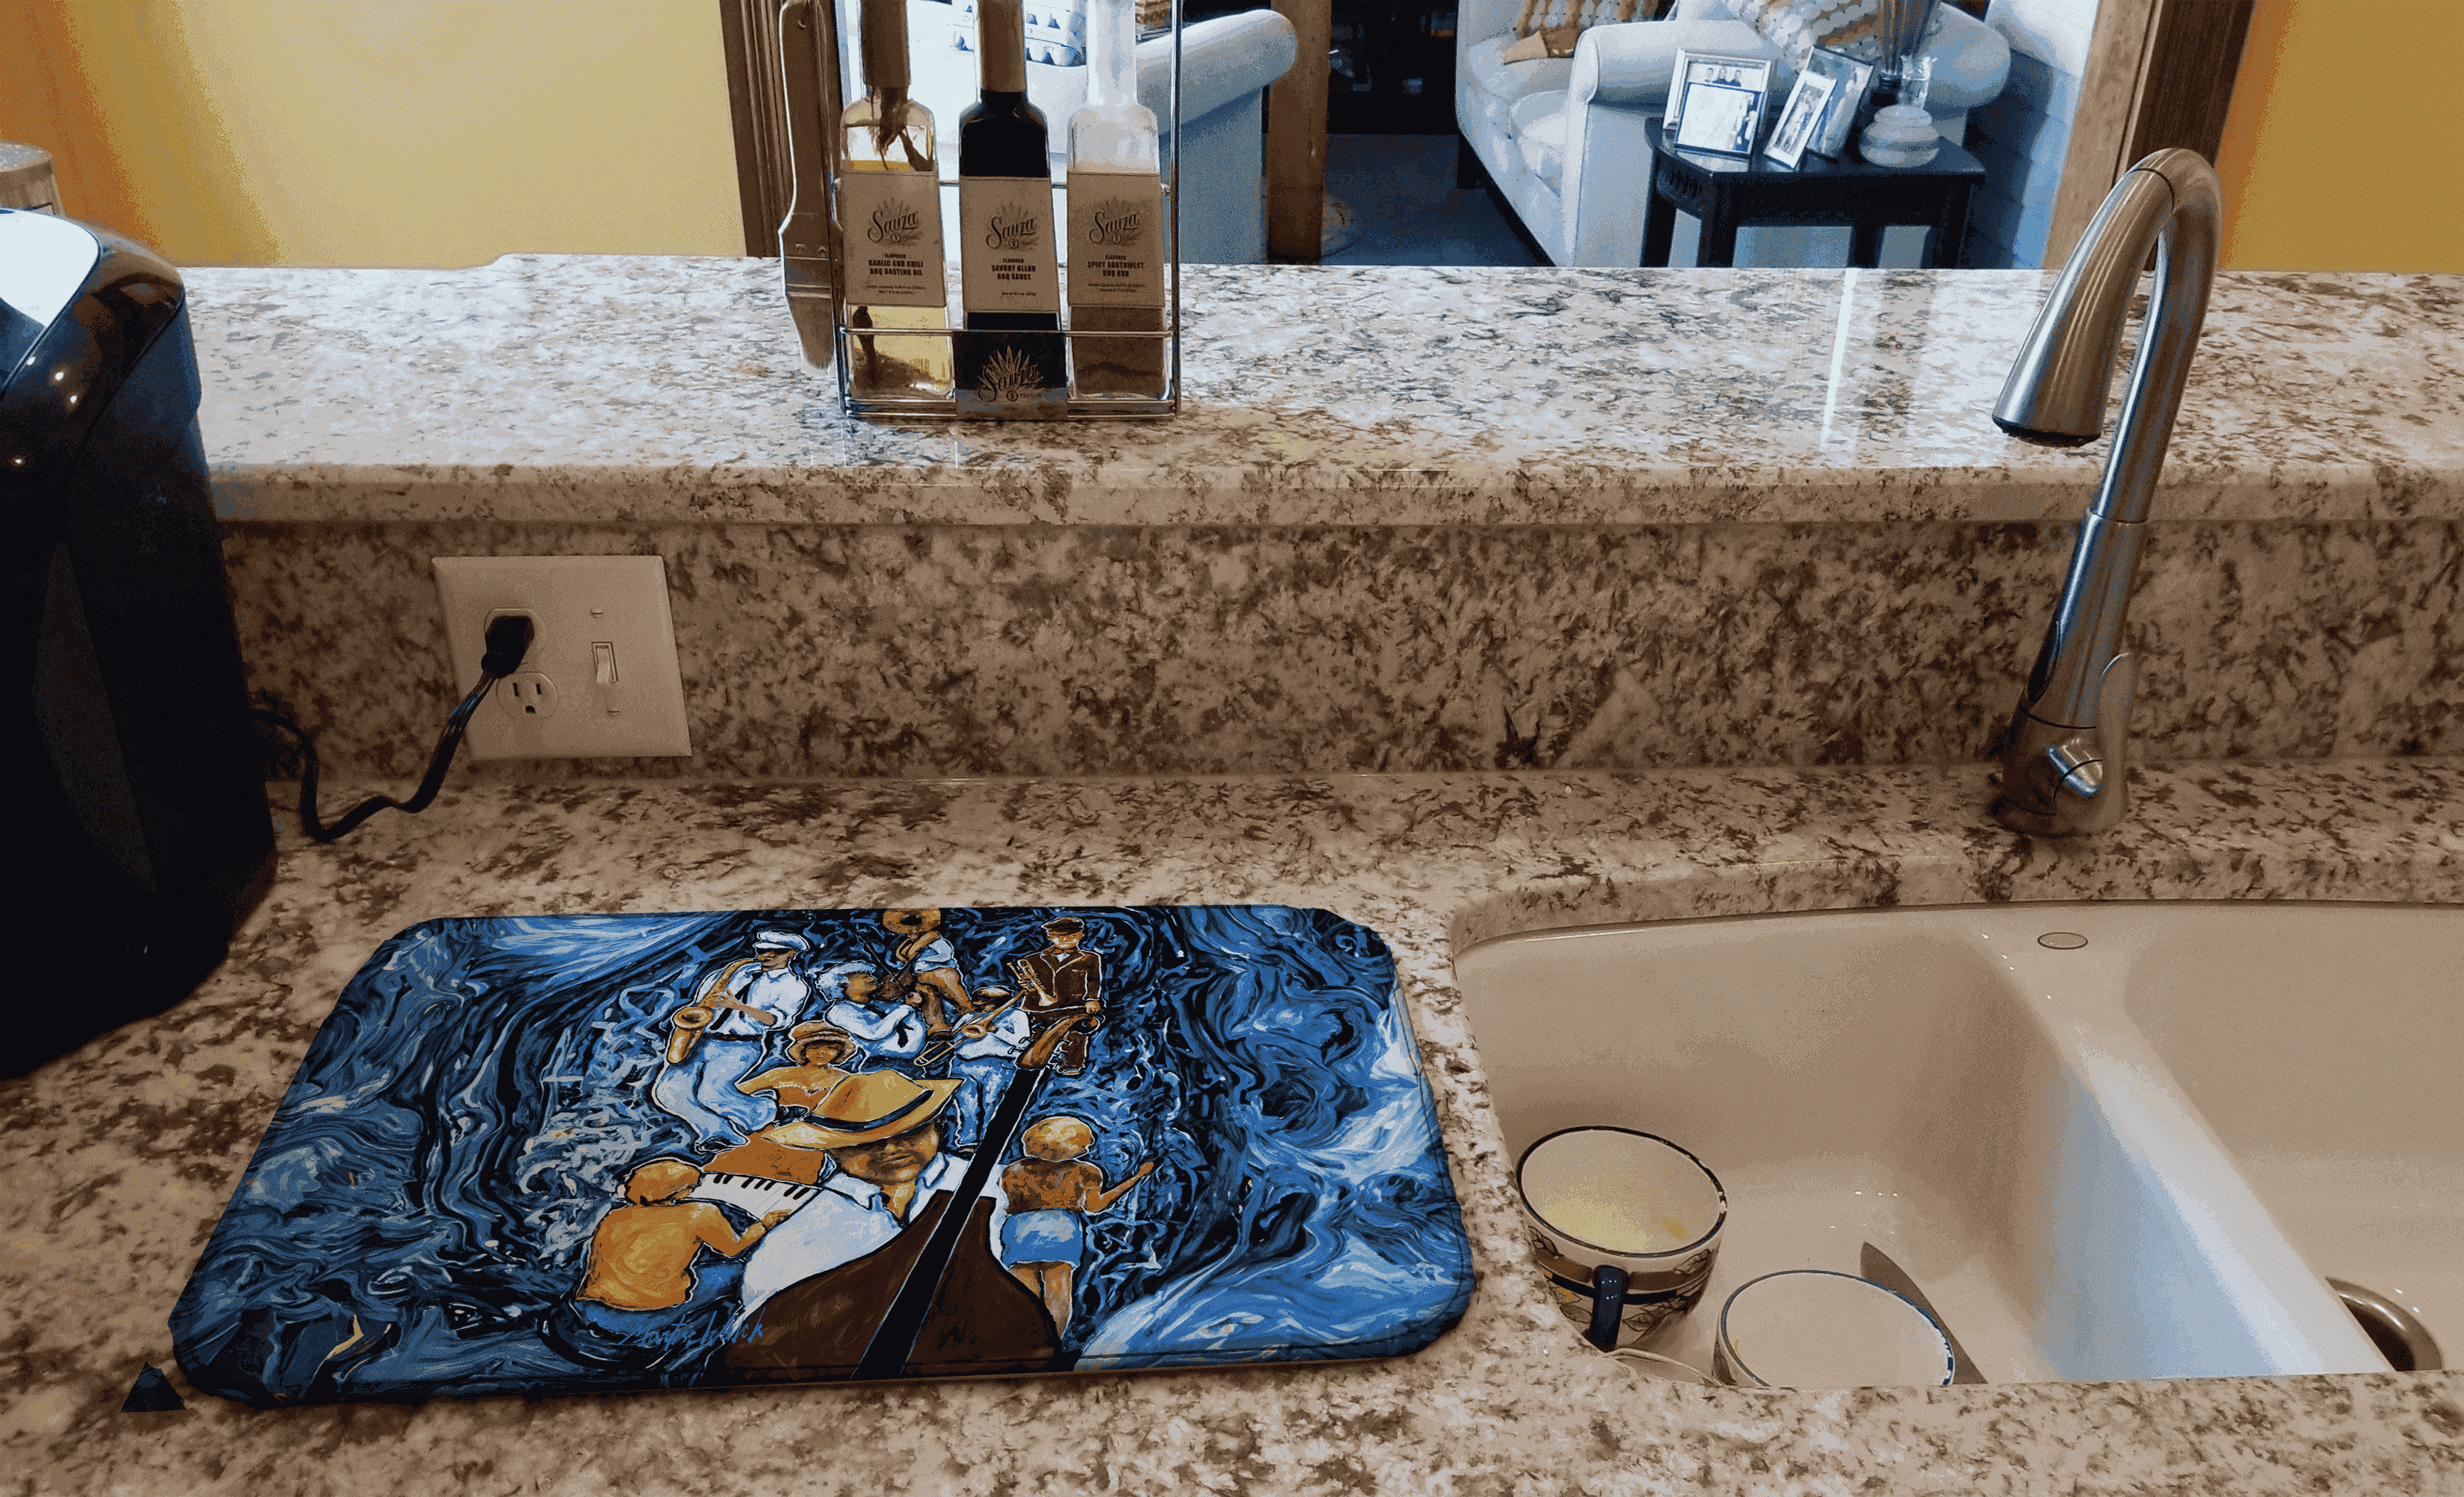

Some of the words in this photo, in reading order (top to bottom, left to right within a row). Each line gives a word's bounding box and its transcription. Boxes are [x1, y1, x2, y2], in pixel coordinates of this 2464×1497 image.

[867, 210, 919, 243] Sauza
[986, 217, 1037, 249] Sauza
[1089, 211, 1140, 244] Sauza
[1108, 261, 1144, 269] SOUTHWEST
